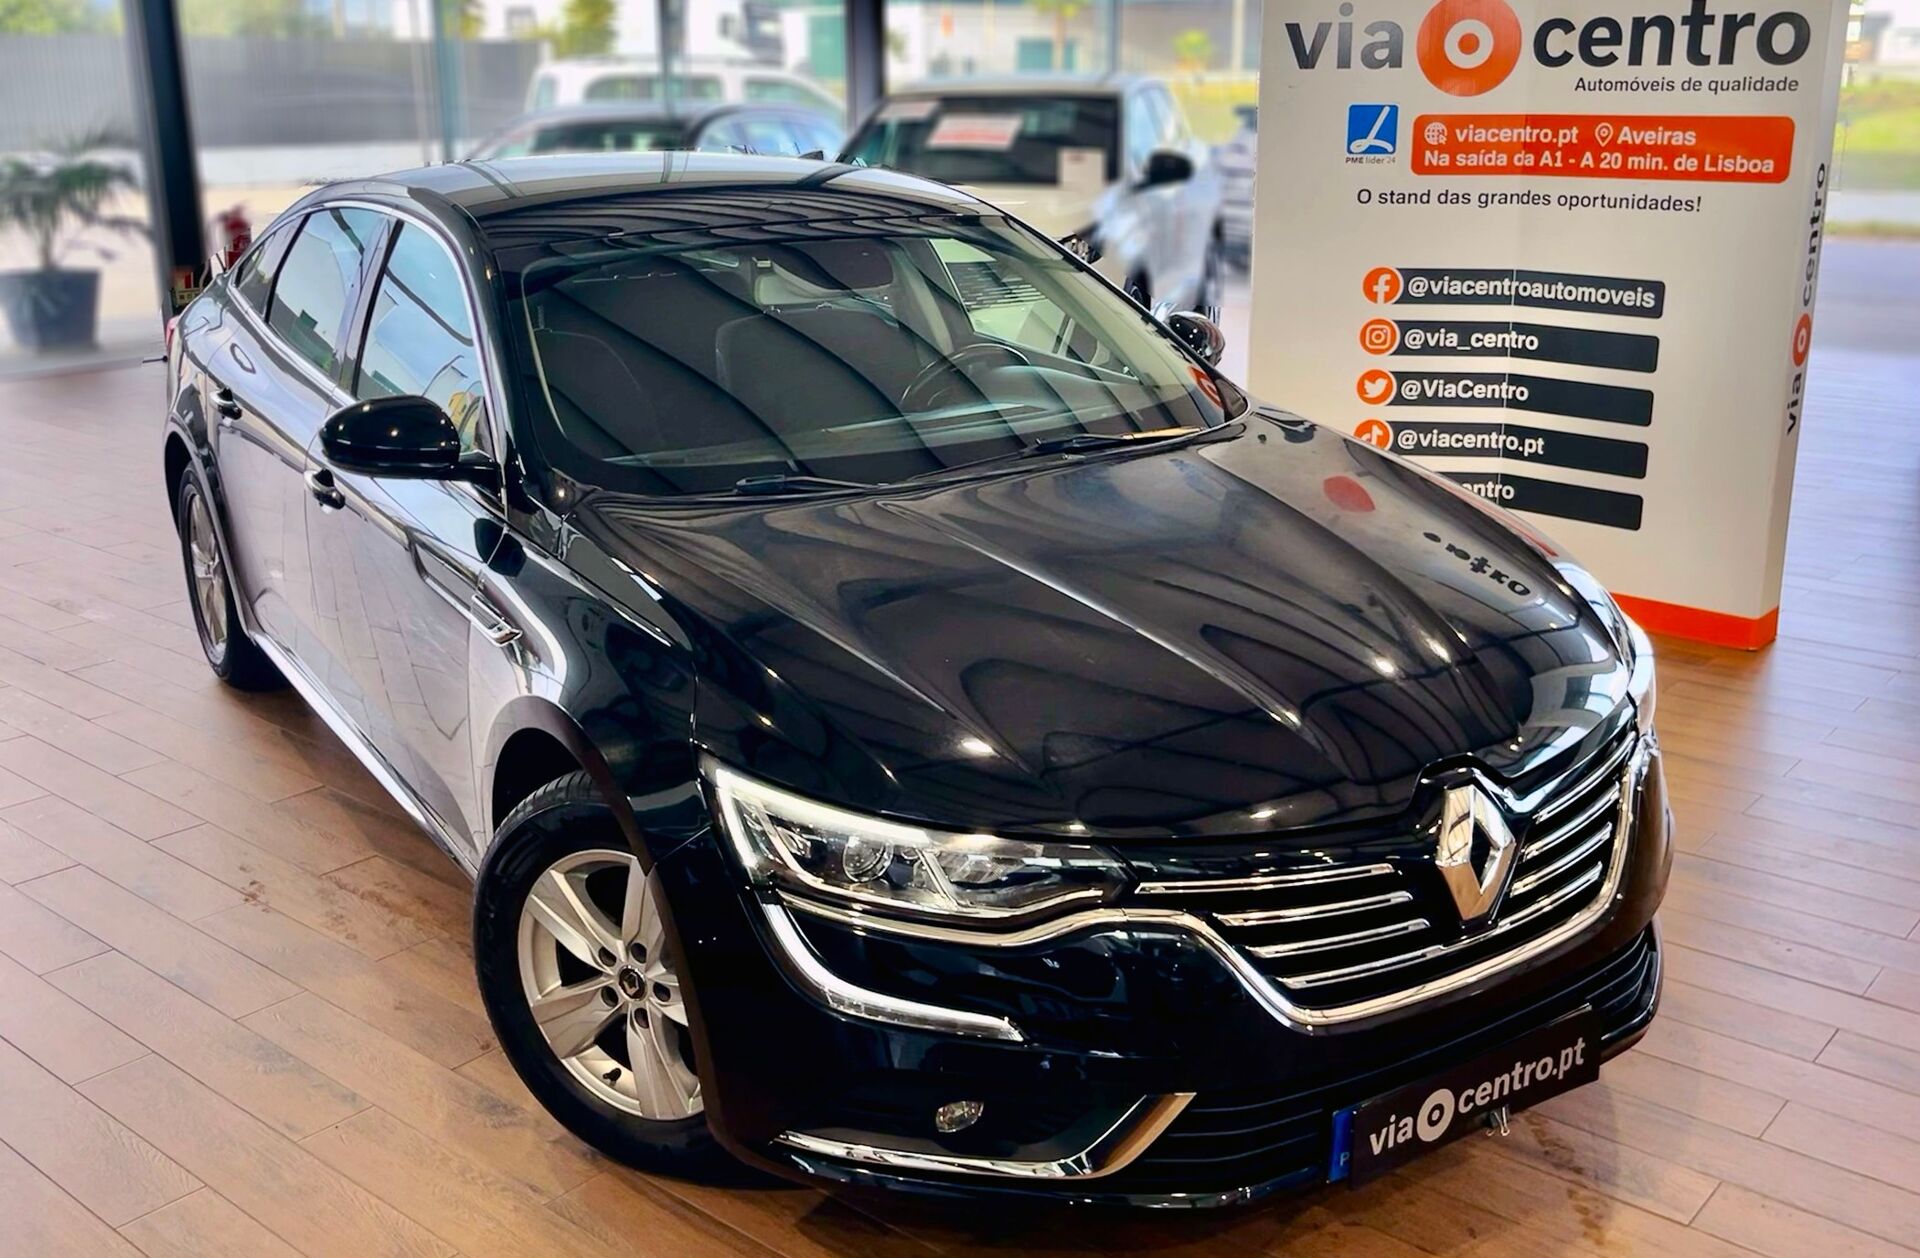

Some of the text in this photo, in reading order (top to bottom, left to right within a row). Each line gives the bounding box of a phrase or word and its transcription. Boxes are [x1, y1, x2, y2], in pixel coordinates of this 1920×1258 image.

[1284, 0, 1811, 70] via centro
[1574, 76, 1799, 96] Automóveis de qualidade
[1454, 124, 1579, 148] viacentro.pt
[1616, 126, 1697, 146] Aveiras
[1345, 156, 1364, 164] PME
[1423, 150, 1450, 167] Na
[1455, 150, 1508, 167] saída
[1513, 150, 1535, 167] da
[1539, 151, 1564, 168] A1
[1580, 153, 1595, 169] A
[1600, 152, 1623, 170] 20
[1627, 152, 1669, 171] min.
[1673, 153, 1699, 172] de
[1704, 154, 1775, 174] Lisboa
[1356, 188, 1702, 213] O stand das grandes oportunidades!
[1407, 275, 1656, 309] @viacentroautomoveis
[1786, 162, 1825, 435] via centro
[1404, 327, 1539, 351] @via_centro
[1400, 379, 1529, 401] @ViaCentro
[1397, 428, 1545, 457] @viacentro.pt
[1369, 1037, 1586, 1156] via centro.pt
